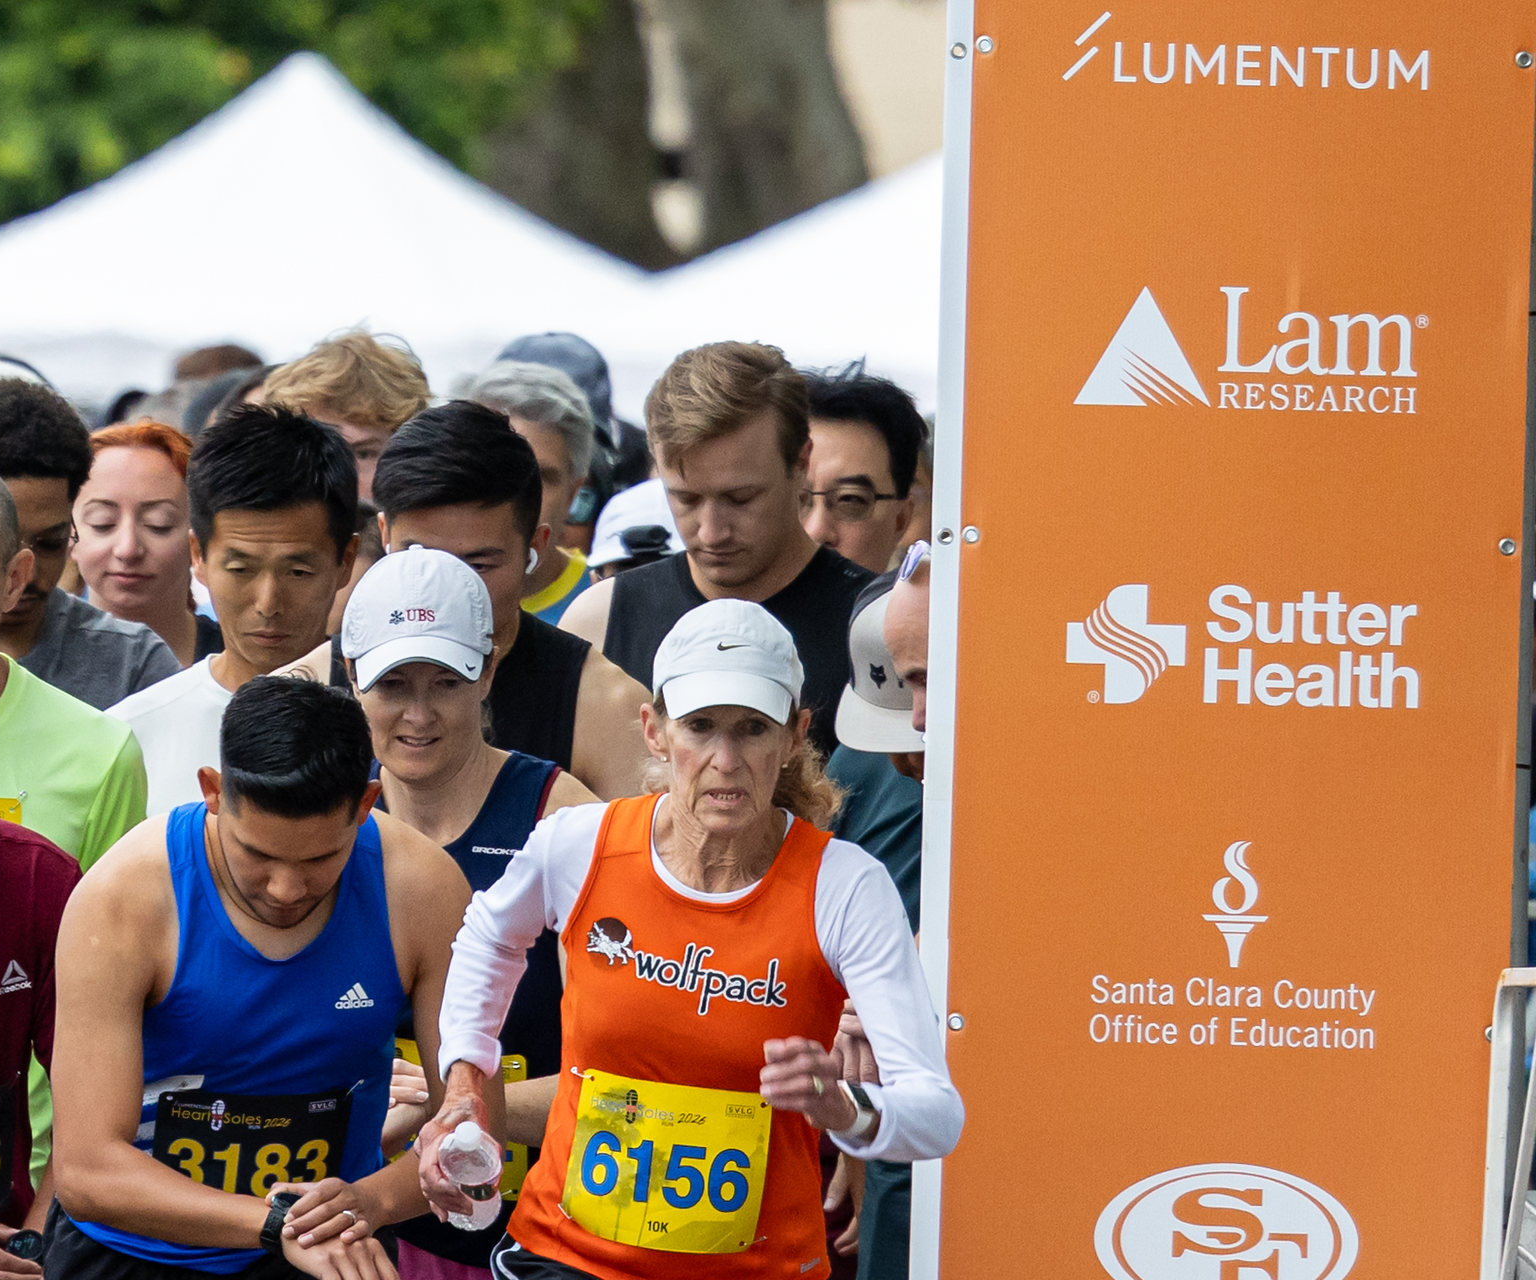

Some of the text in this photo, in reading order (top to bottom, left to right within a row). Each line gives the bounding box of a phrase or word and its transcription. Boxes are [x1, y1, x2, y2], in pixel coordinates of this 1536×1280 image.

[1115, 43, 1430, 91] LUMENTUM
[1220, 384, 1417, 414] RESEARCH
[406, 609, 436, 623] UBS
[1207, 586, 1418, 647] Sutter
[1204, 649, 1420, 709] Health
[634, 942, 788, 1016] wolfpack
[1092, 976, 1376, 1017] Santa Clara County
[335, 999, 375, 1010] adidas
[1091, 1015, 1375, 1049] Office of Education
[172, 1106, 214, 1122] Heart
[223, 1113, 262, 1127] Soles
[168, 1137, 330, 1199] 3183
[581, 1129, 751, 1214] 6156
[646, 1219, 669, 1234] 10K
